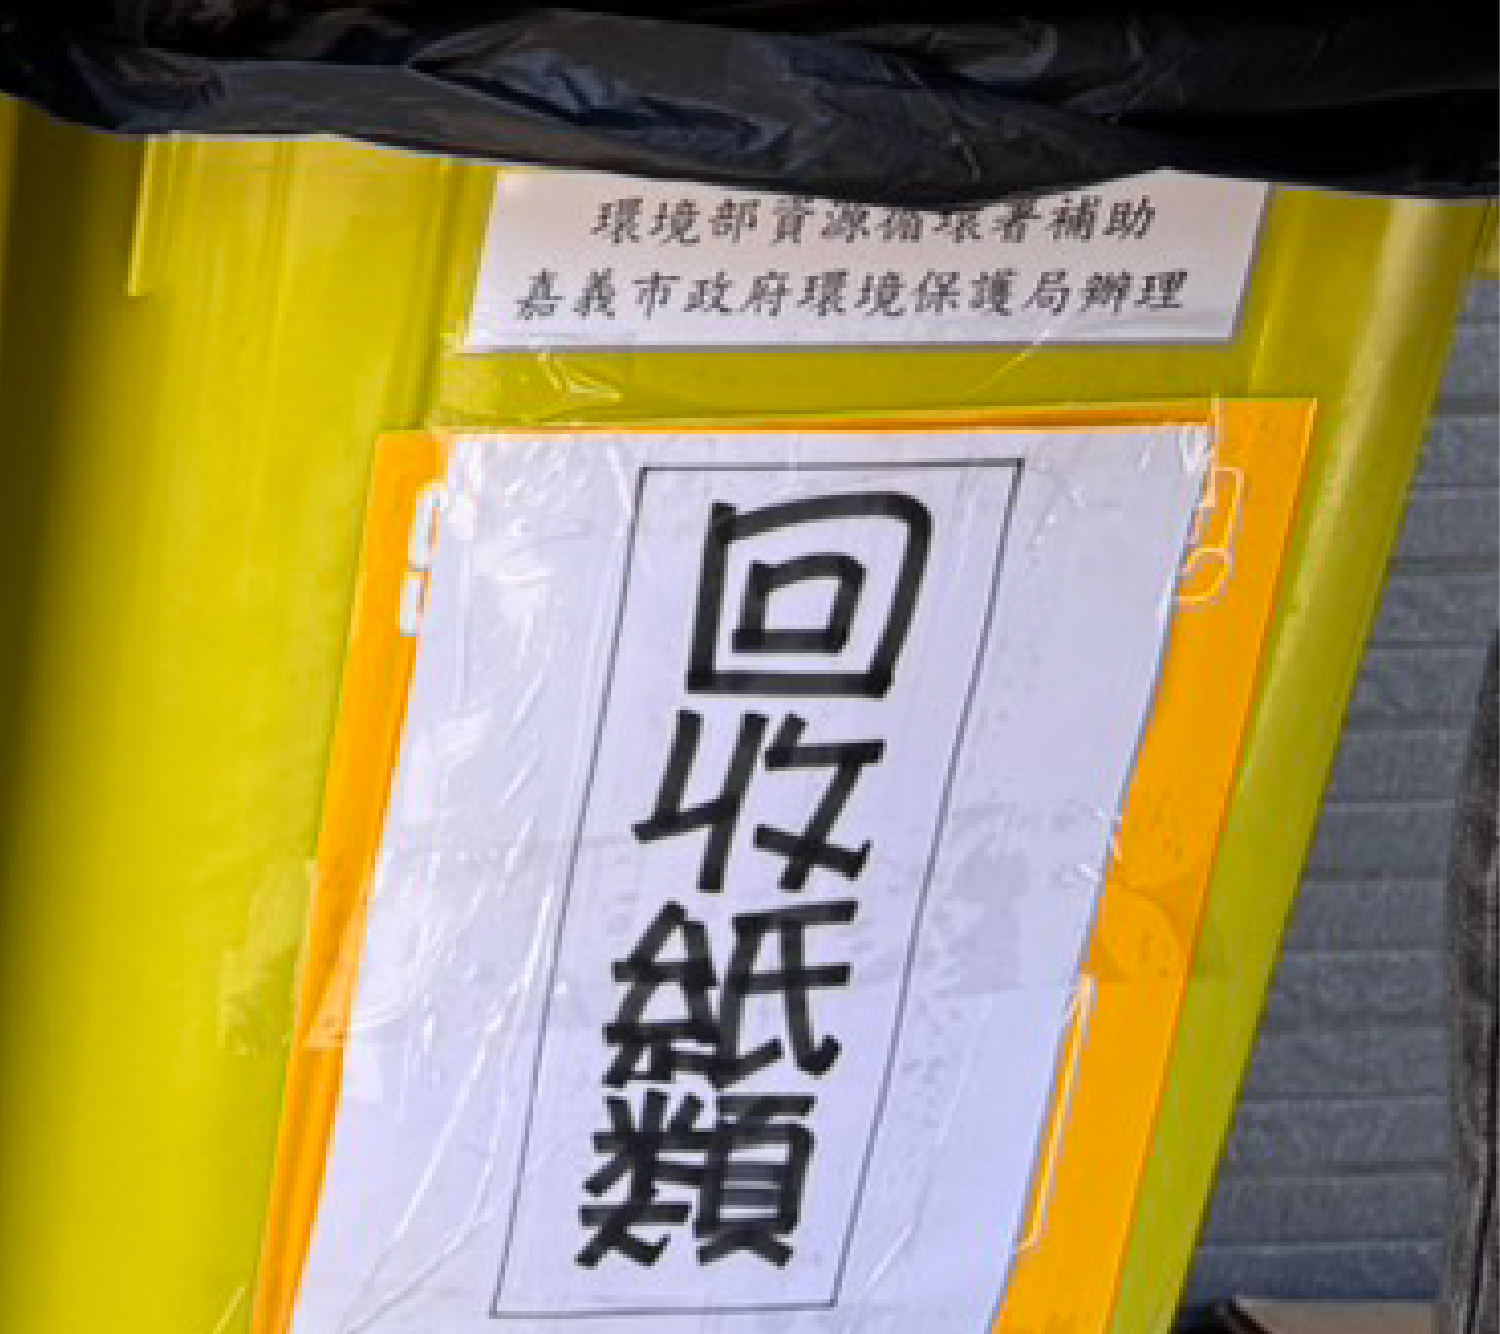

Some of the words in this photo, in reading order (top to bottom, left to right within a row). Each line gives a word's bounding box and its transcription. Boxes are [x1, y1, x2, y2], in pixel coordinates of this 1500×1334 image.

[514, 267, 1191, 322] 嘉義市政府環境保護局辦理
[577, 488, 934, 1271] 回收紙類
